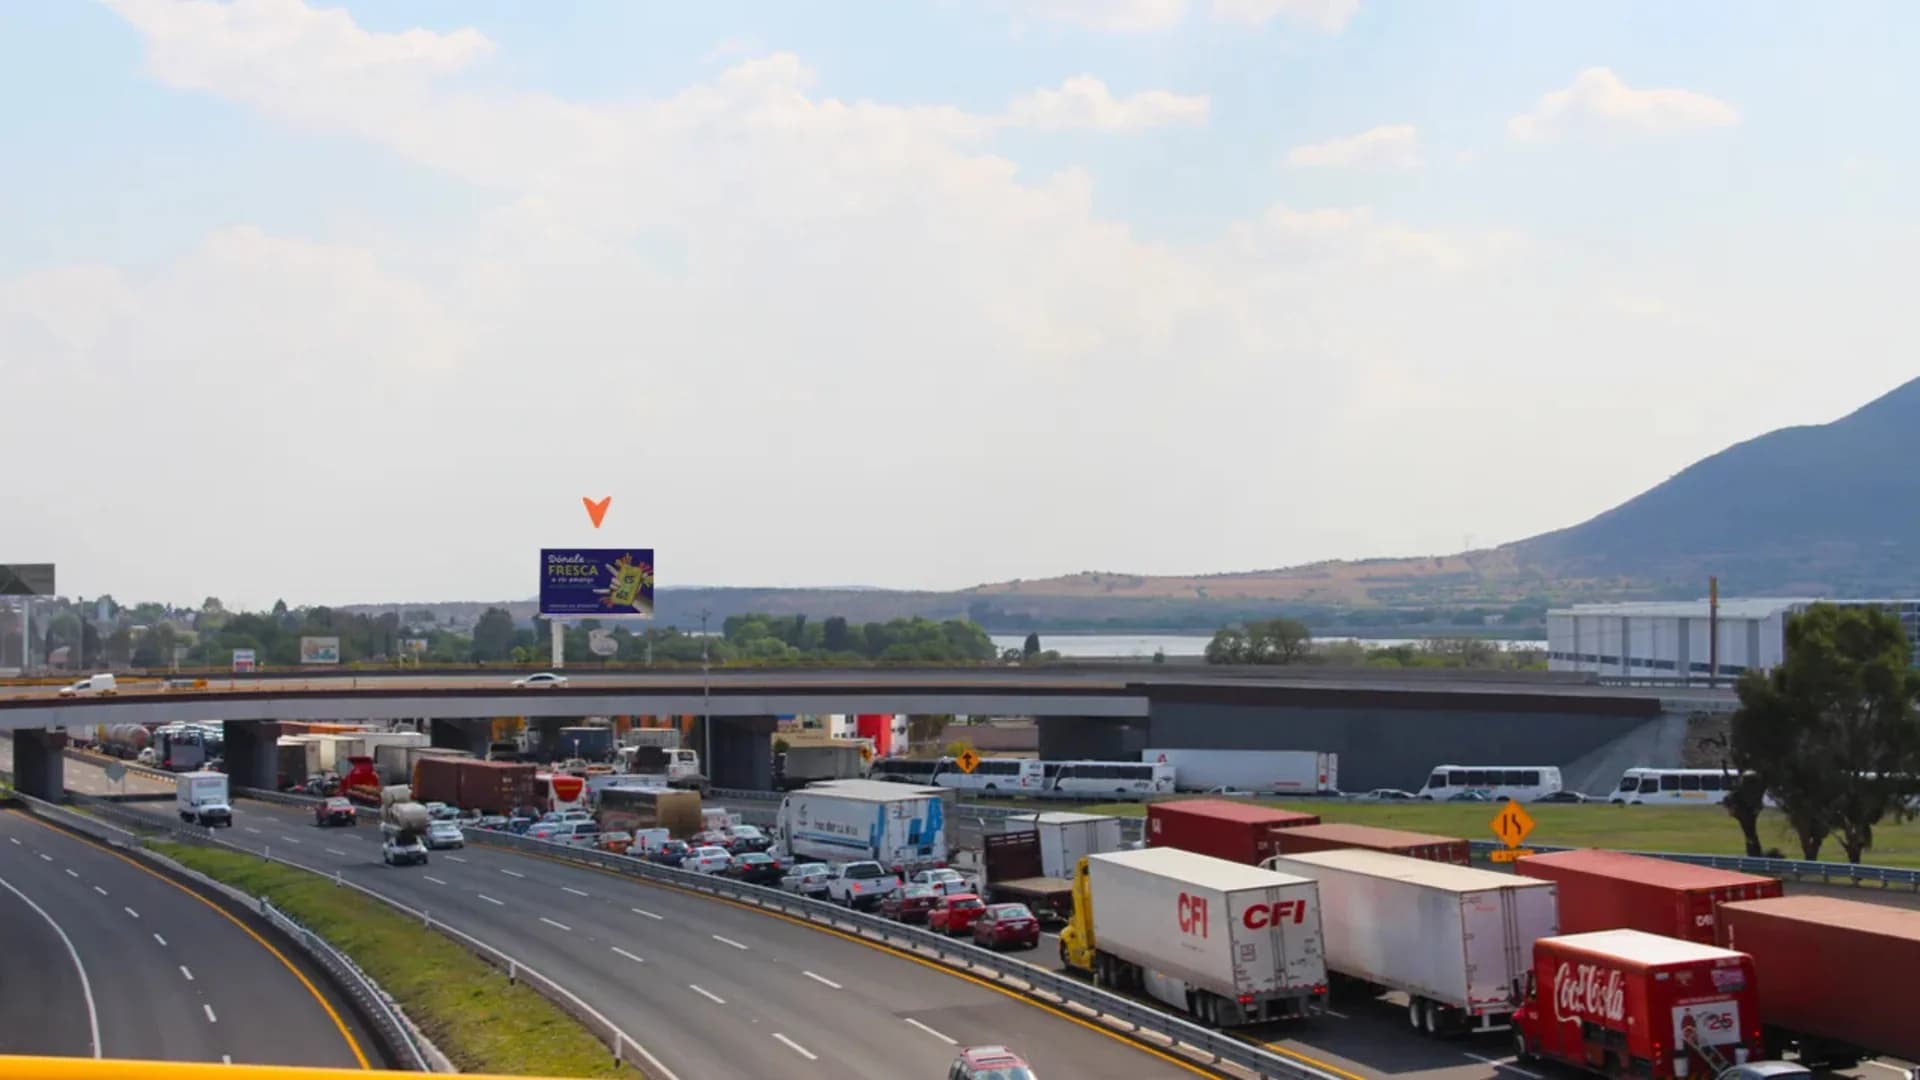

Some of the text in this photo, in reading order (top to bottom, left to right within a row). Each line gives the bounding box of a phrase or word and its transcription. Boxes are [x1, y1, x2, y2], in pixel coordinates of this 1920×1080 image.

[548, 564, 599, 577] FRESCA
[1178, 892, 1208, 939] CFI
[1242, 899, 1306, 930] CFI
